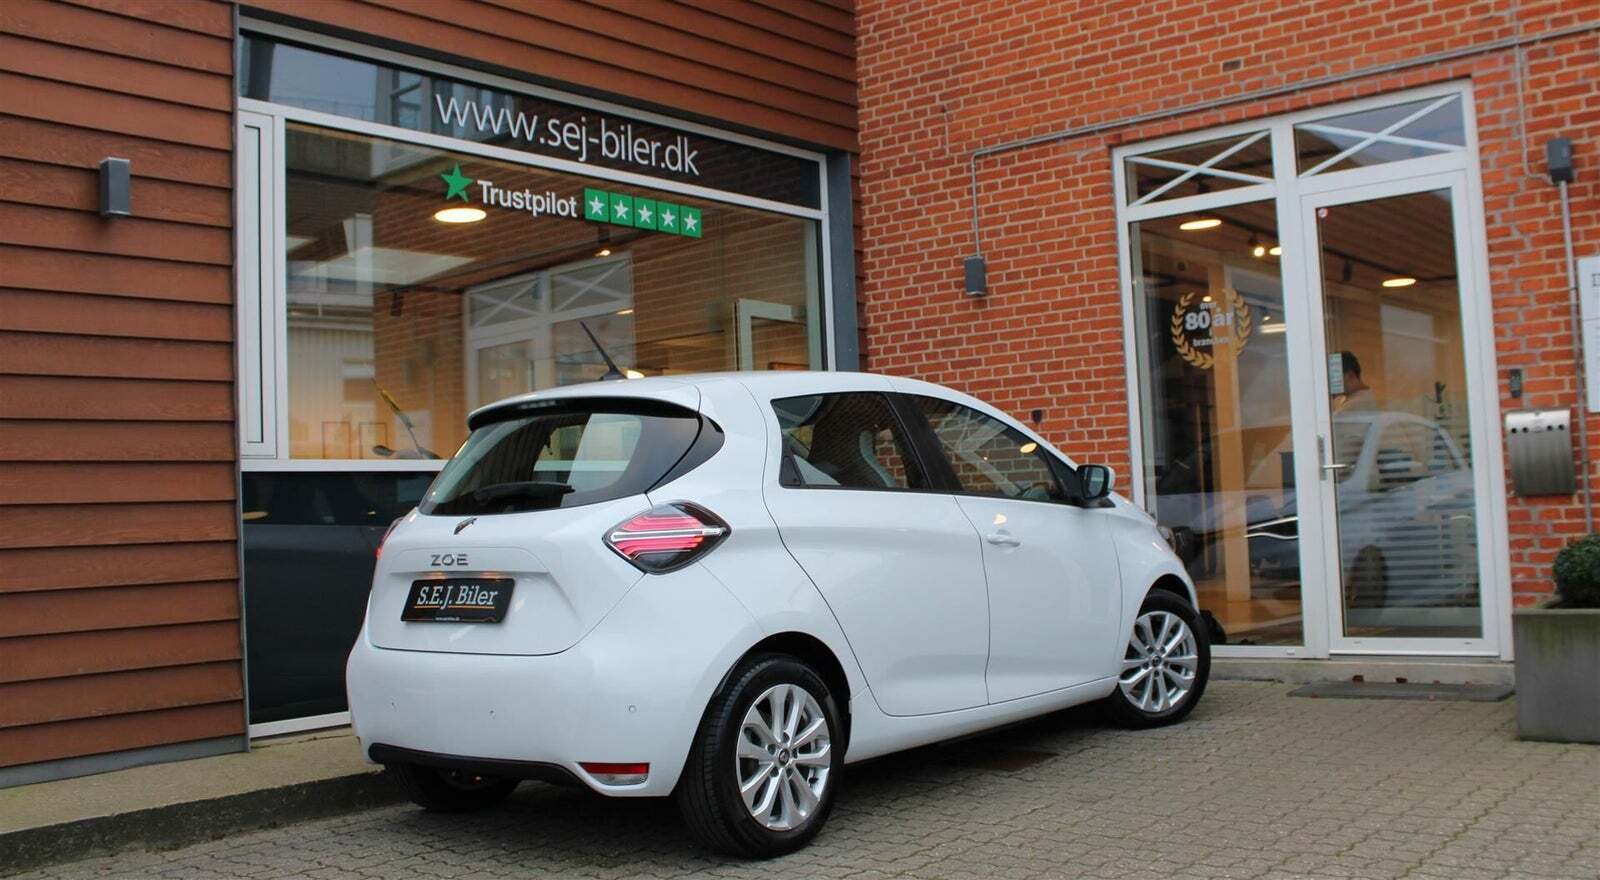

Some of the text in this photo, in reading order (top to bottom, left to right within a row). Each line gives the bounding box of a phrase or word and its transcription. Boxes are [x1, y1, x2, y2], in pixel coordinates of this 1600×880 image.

[435, 94, 700, 176] www.sej-biler.dk
[477, 179, 578, 218] Trustpilot
[1185, 311, 1211, 330] 80
[431, 553, 469, 566] ZOE
[416, 585, 498, 610] S.E.J. Biler
